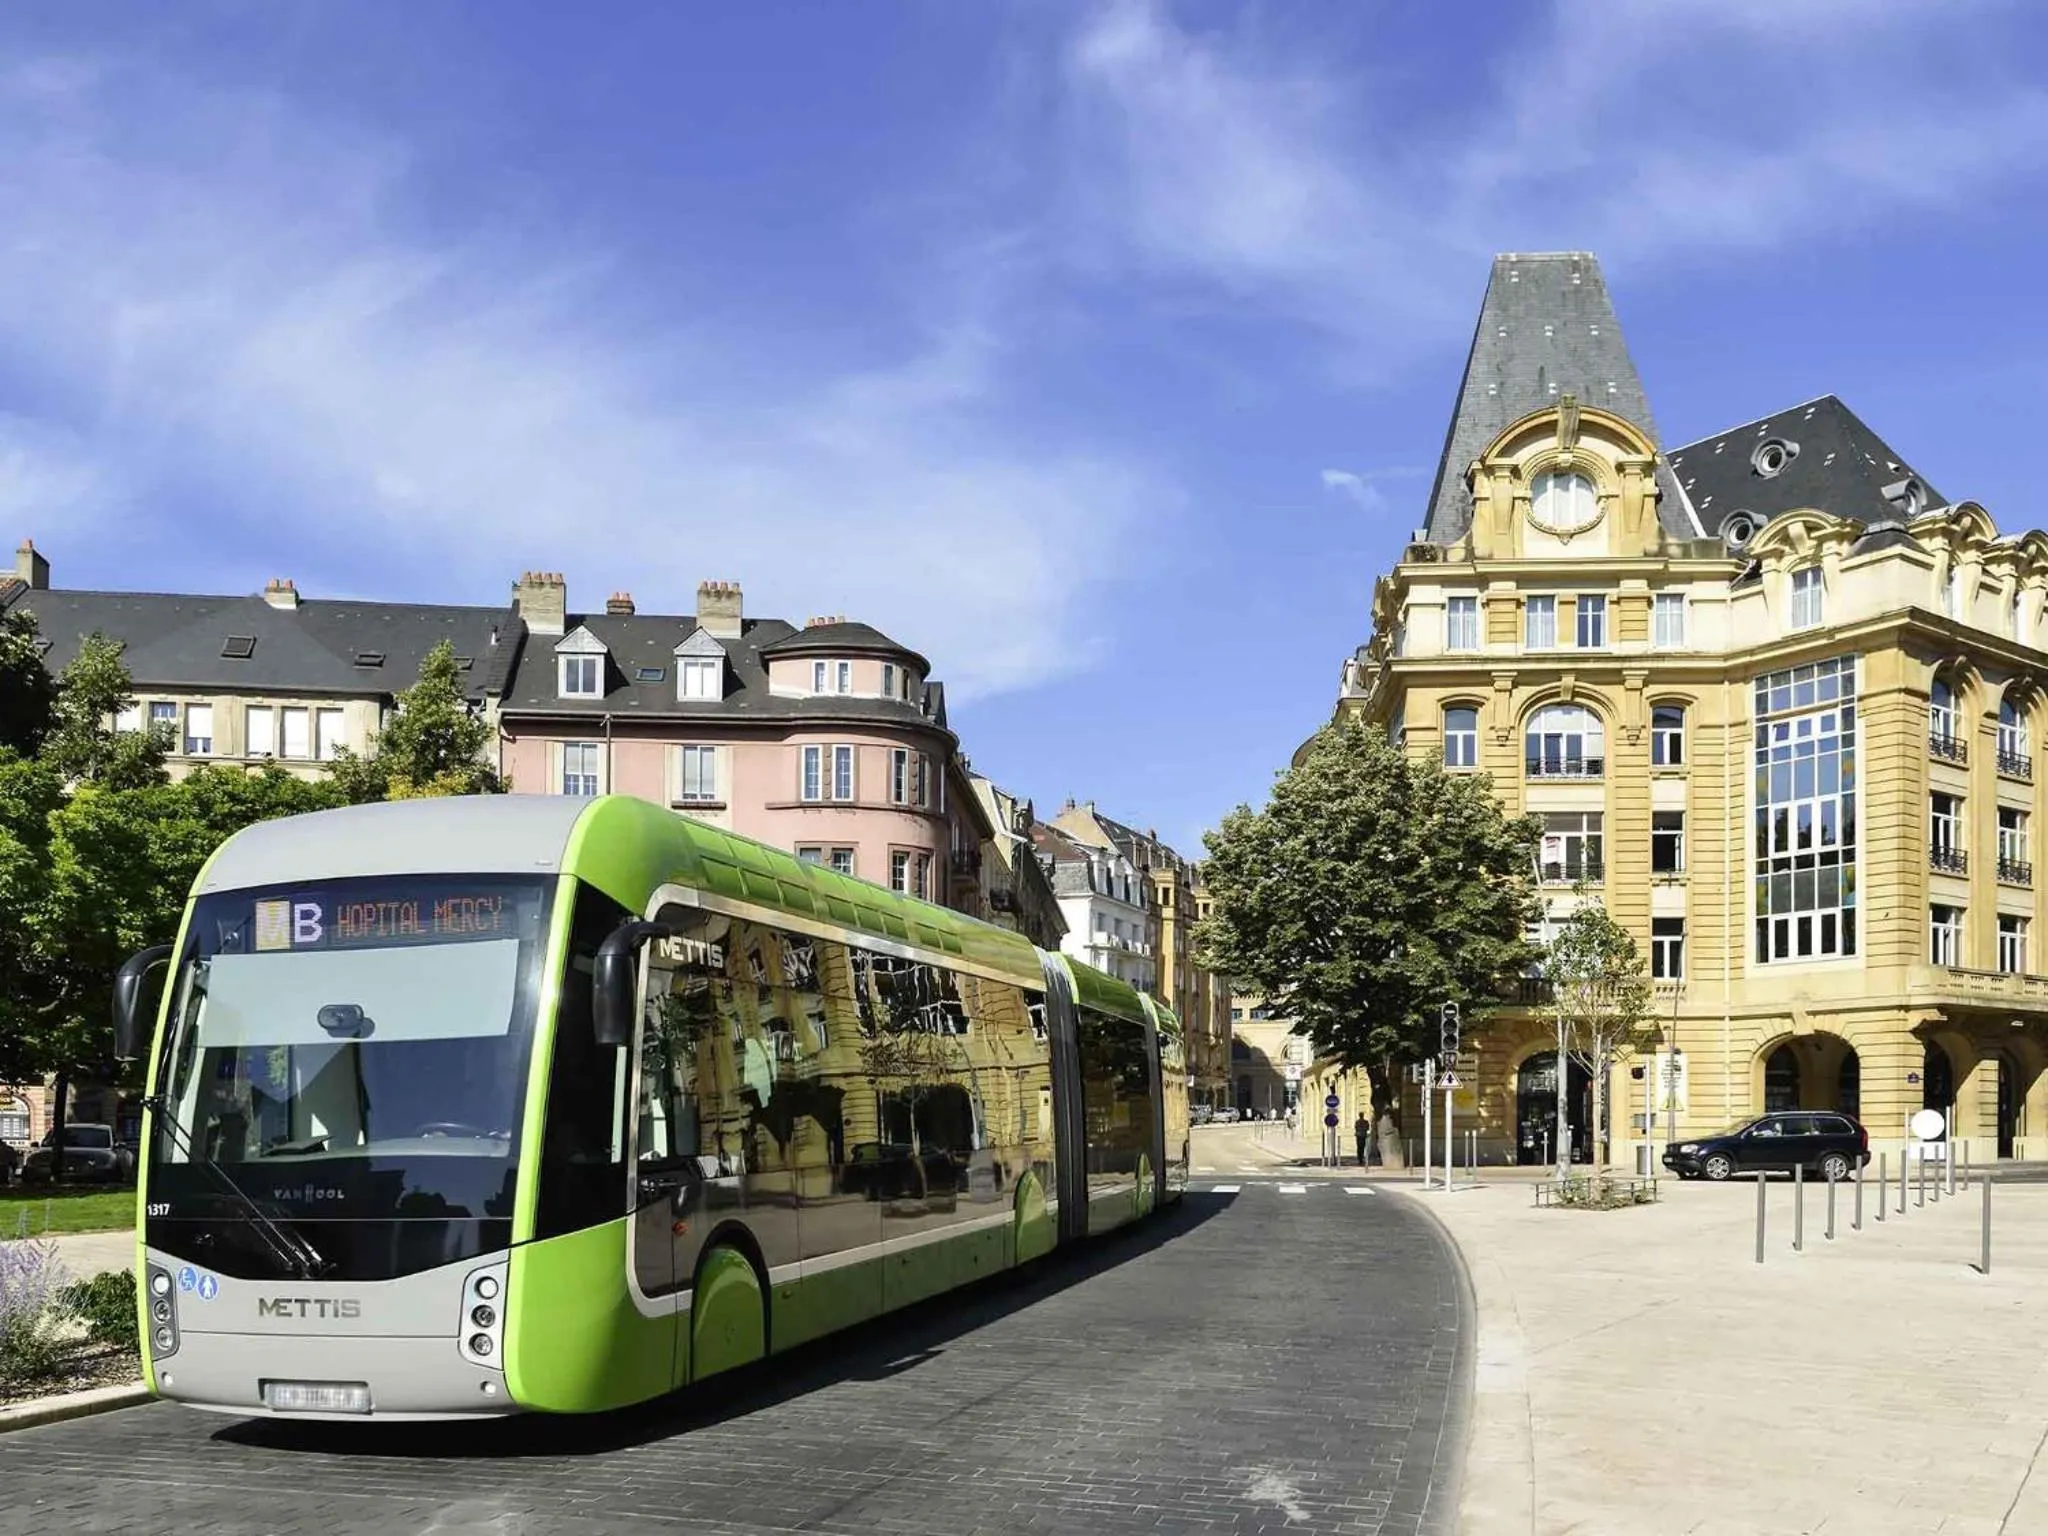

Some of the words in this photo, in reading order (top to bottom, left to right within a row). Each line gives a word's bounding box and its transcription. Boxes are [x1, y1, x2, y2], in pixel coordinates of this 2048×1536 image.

[294, 902, 323, 943] B
[337, 901, 427, 938] HOPITAL
[433, 896, 502, 933] MERCY
[659, 935, 724, 968] METTIS
[147, 1203, 170, 1216] 1317
[259, 1298, 361, 1319] METTIS
